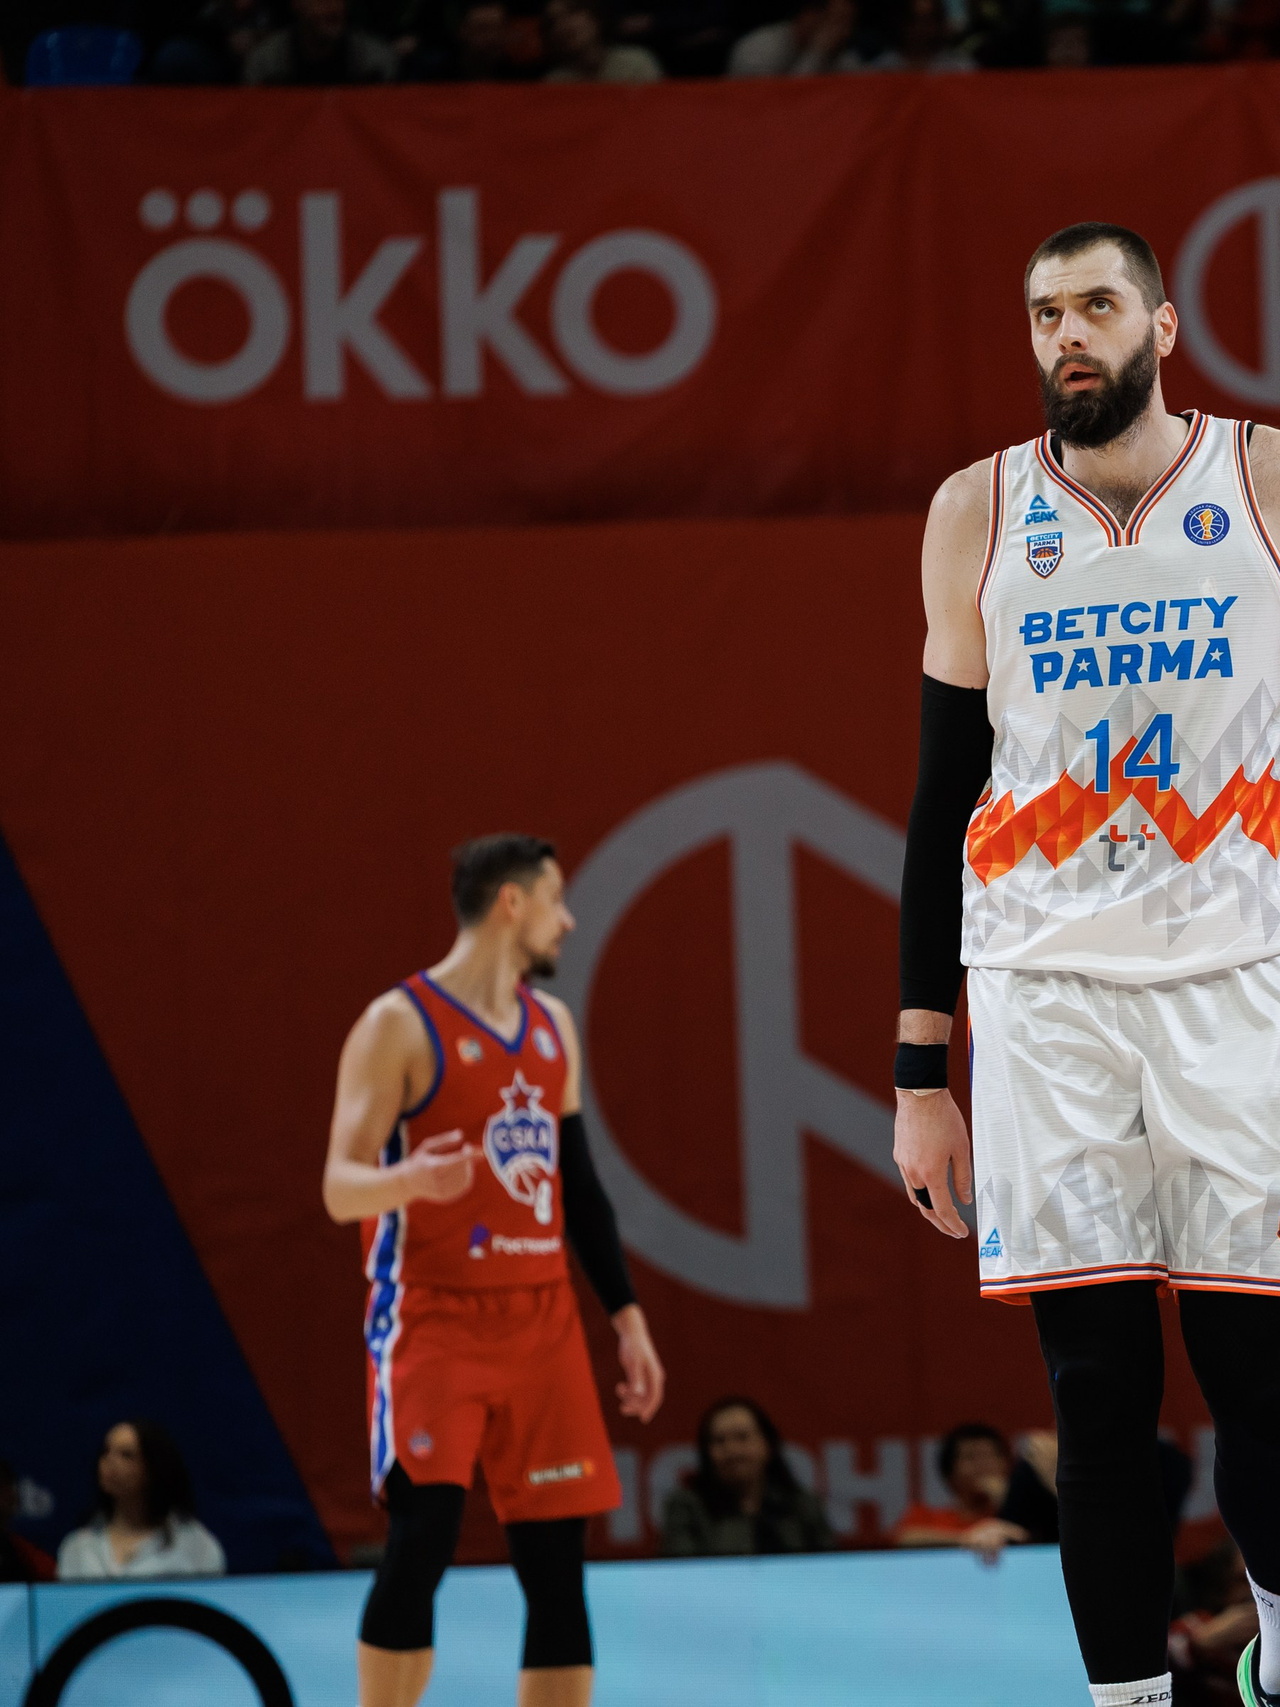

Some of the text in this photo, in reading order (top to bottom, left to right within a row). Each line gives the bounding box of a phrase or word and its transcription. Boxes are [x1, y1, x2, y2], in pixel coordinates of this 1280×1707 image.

[1025, 509, 1059, 526] PEAK
[1030, 533, 1060, 541] BETCITY
[1019, 596, 1238, 645] BETCITY
[1030, 638, 1234, 693] PARMA
[1085, 713, 1180, 793] 14
[979, 1244, 1003, 1259] PEAK
